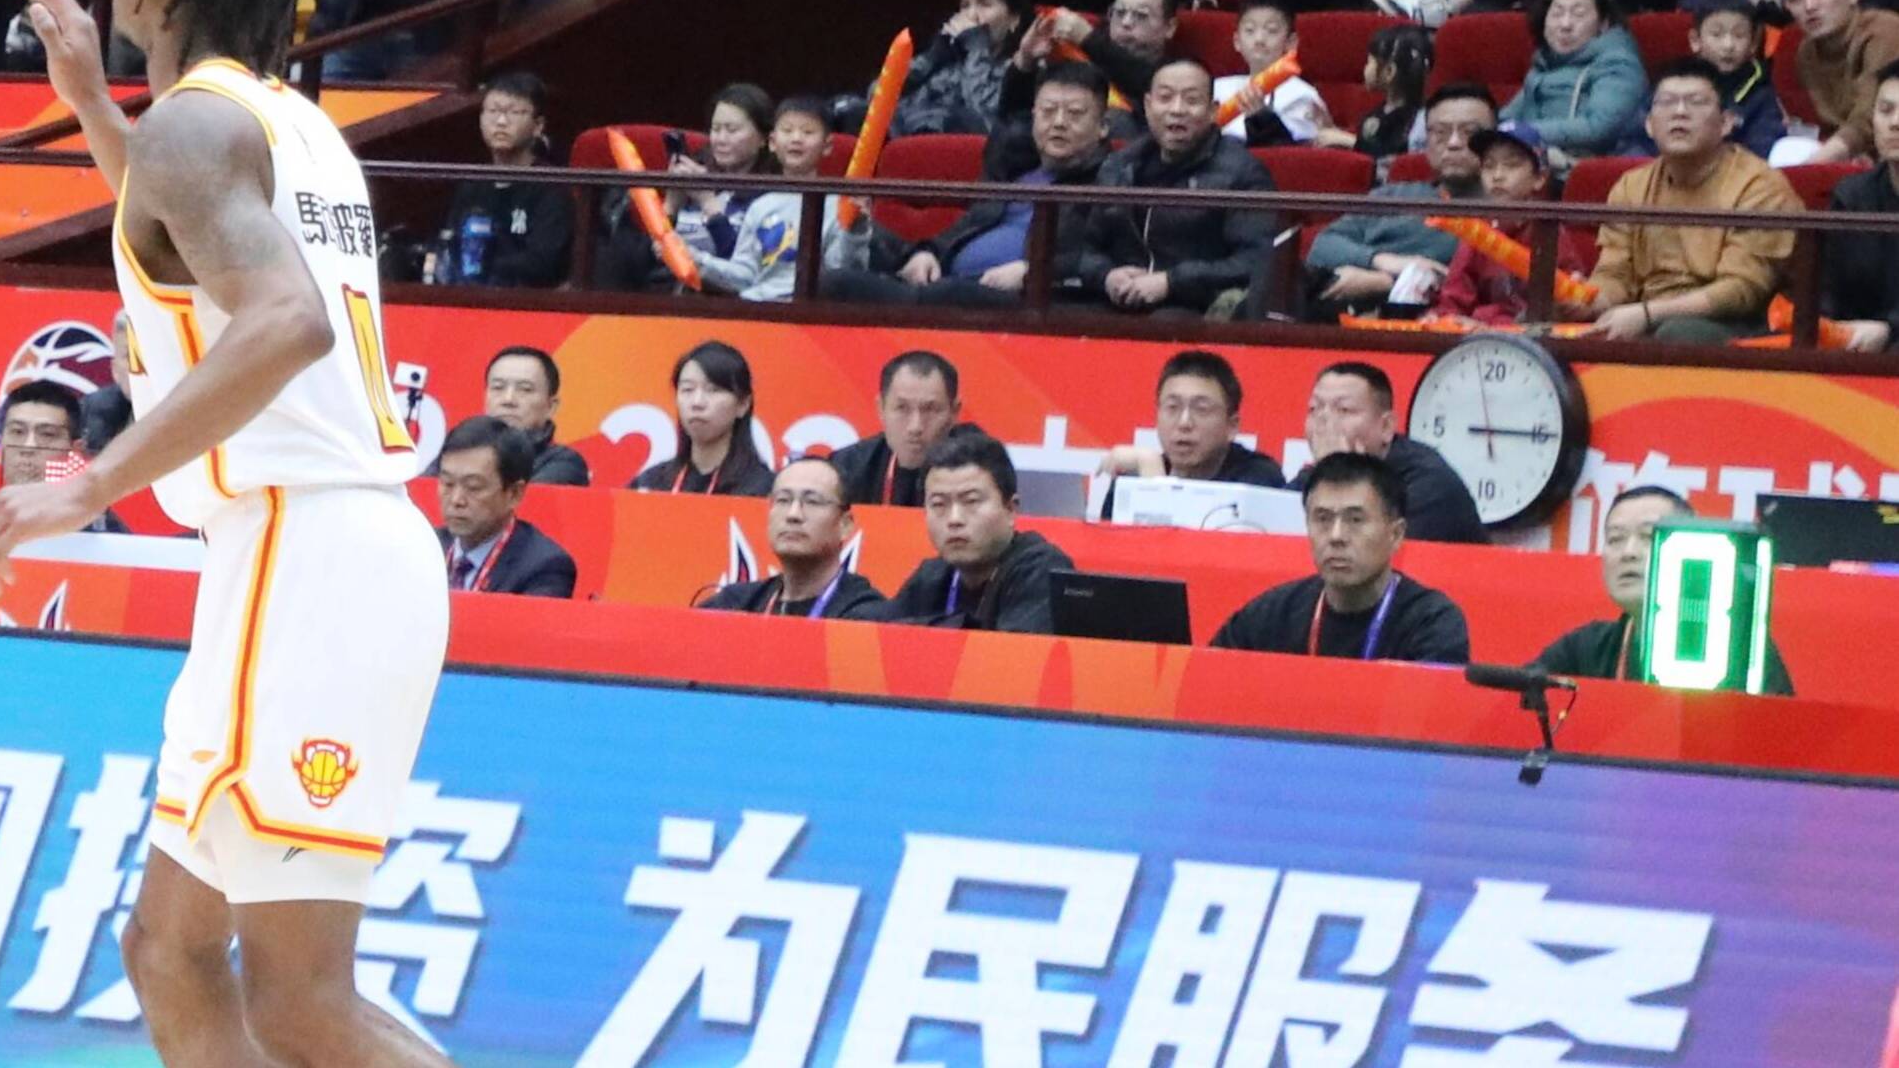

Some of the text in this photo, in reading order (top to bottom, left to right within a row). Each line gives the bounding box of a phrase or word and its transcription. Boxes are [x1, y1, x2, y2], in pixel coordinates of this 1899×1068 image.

[1483, 362, 1507, 383] 20
[1433, 415, 1446, 438] 5
[1531, 423, 1550, 445] 15
[1477, 478, 1496, 501] 10
